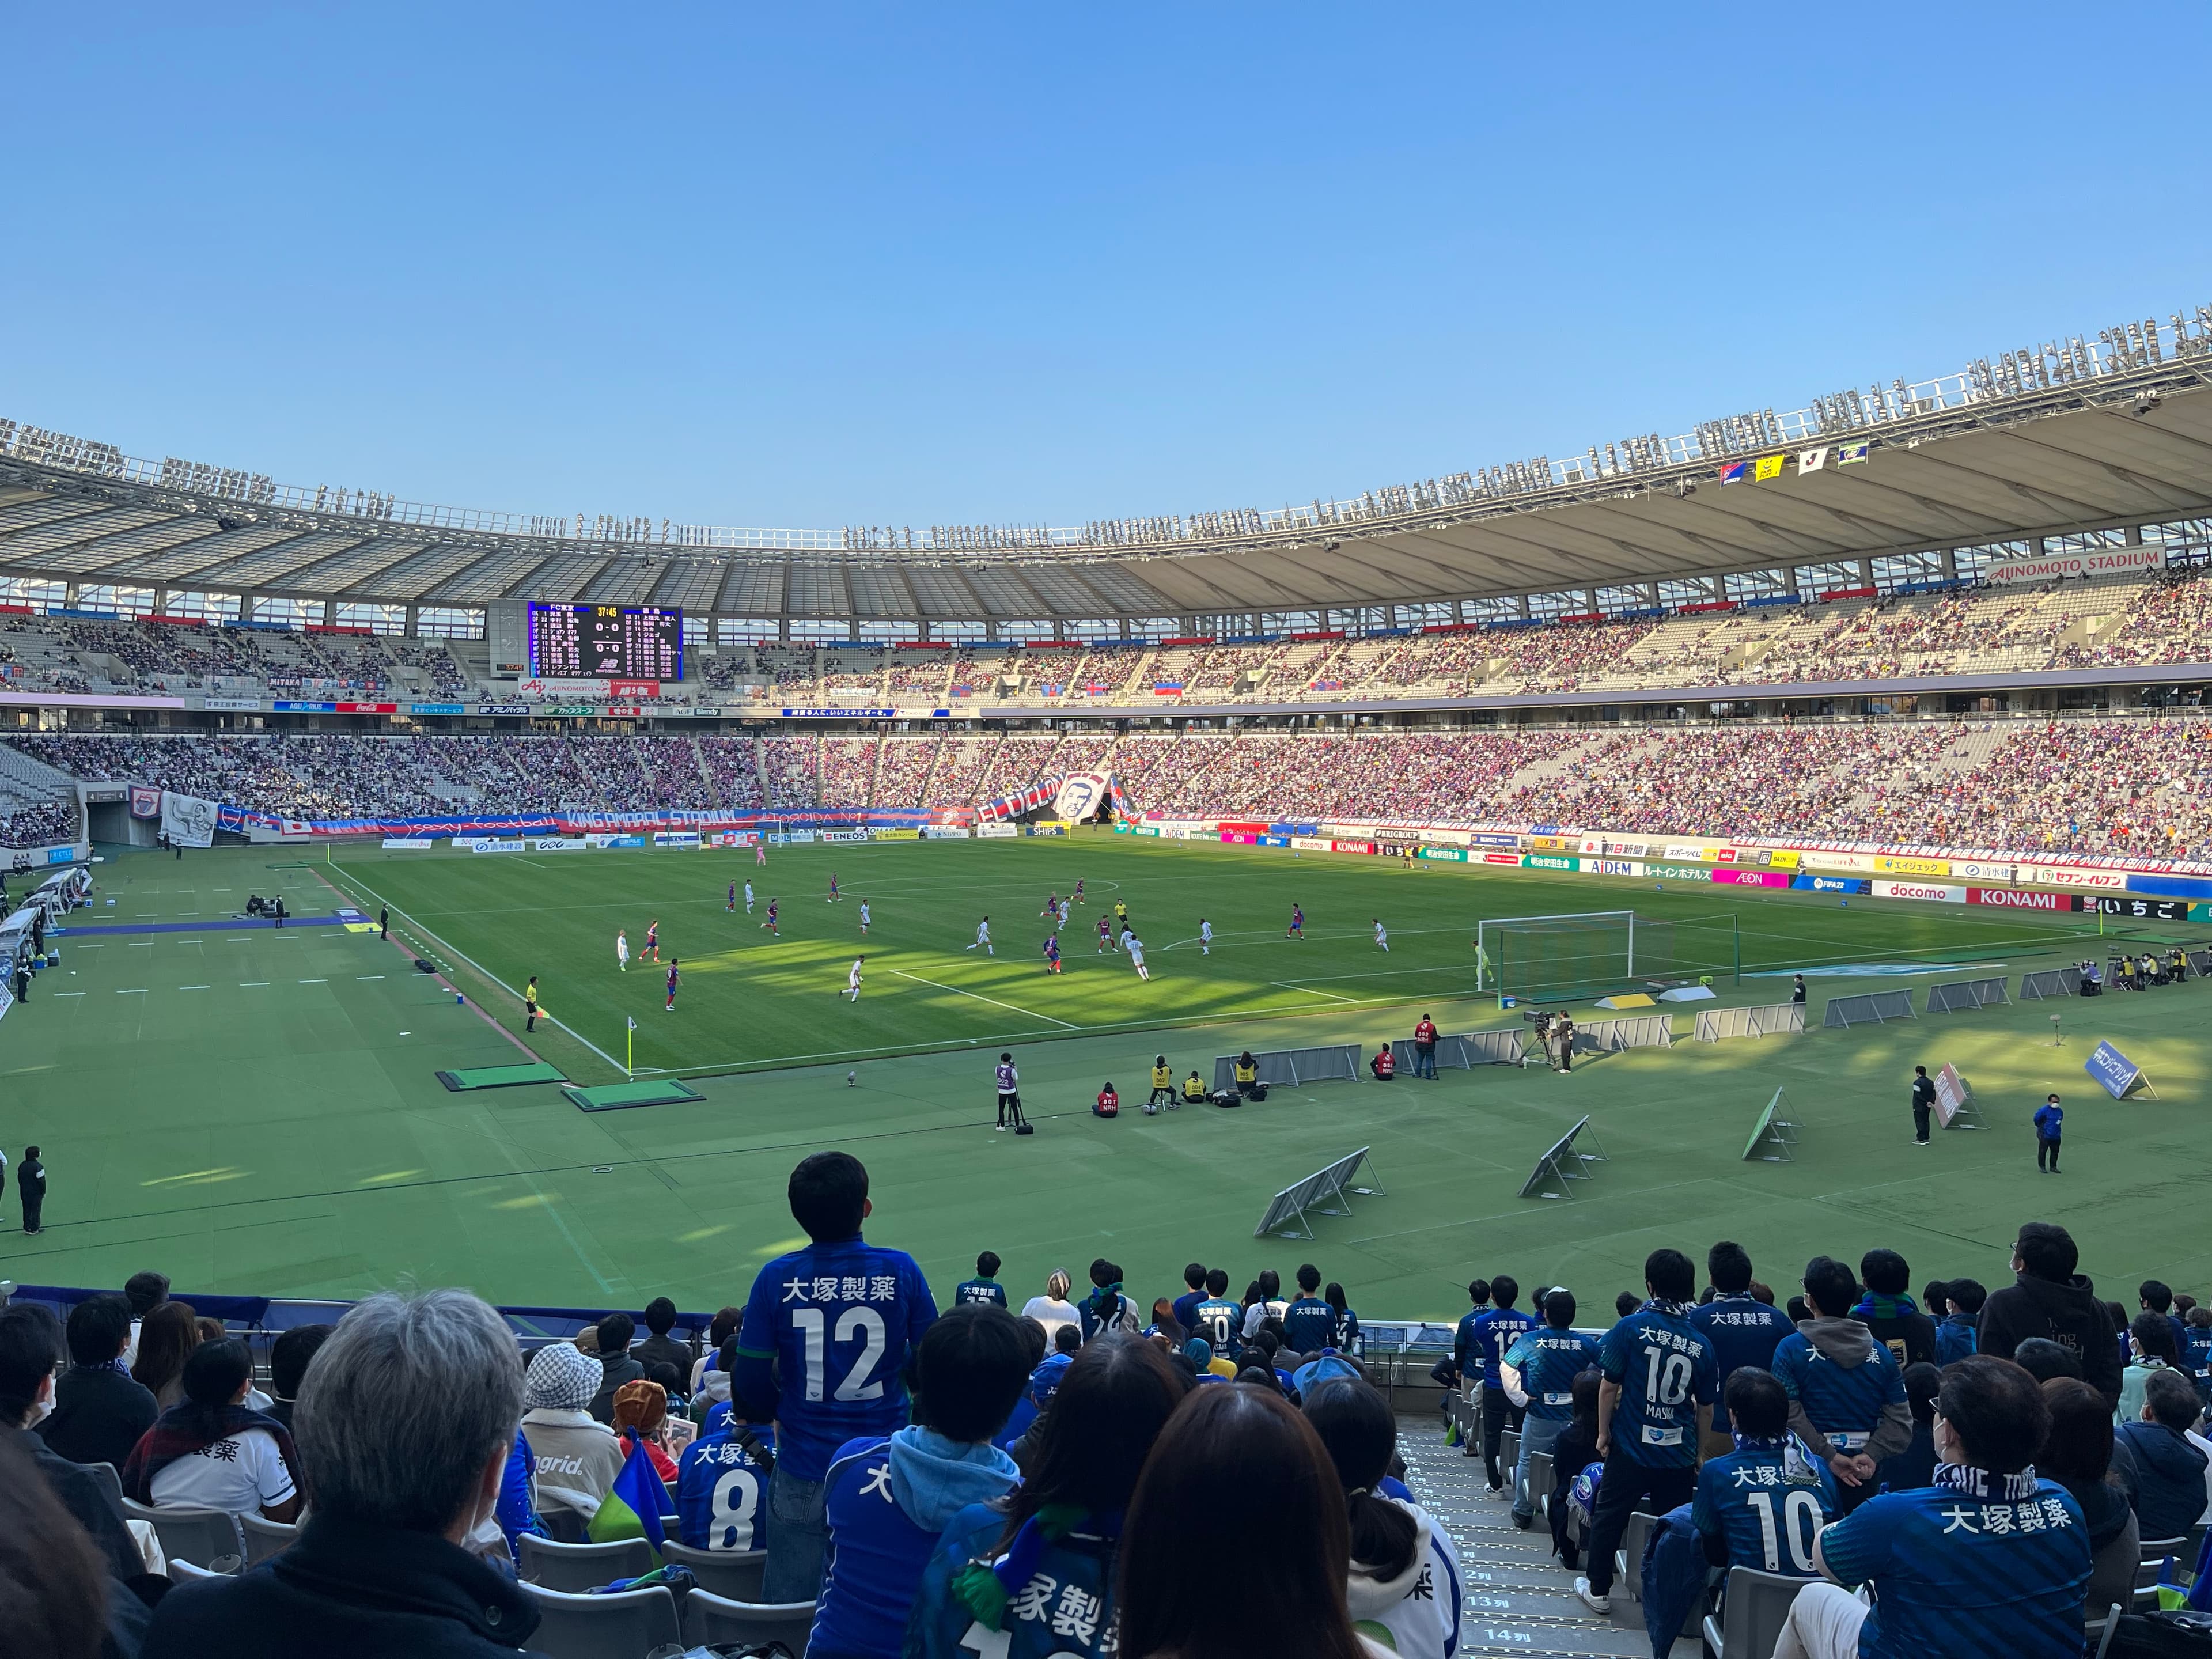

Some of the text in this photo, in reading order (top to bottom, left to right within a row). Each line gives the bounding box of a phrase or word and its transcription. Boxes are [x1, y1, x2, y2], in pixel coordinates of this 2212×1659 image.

[1990, 551, 2158, 580] AJINOMOTO STADIUM
[598, 607, 616, 617] 37:45
[269, 677, 300, 686] MITAKA
[289, 702, 323, 710] AQUARIUS
[2011, 701, 2020, 709] 35
[2112, 698, 2122, 707] 34
[491, 706, 528, 714] アミノバイタル
[791, 709, 887, 717] 頑張る人に、いいエネルギーを。
[567, 810, 736, 828] KING AMARAL STADIUM
[414, 816, 556, 836] sexy-football
[1033, 827, 1056, 835] SHIPS
[1190, 831, 1203, 840] ROUTE
[1300, 839, 1323, 849] docomo
[1336, 843, 1368, 853] KONAMI
[1605, 843, 1643, 855] 朝日新聞
[1426, 849, 1460, 861] 明治安田生命
[1668, 848, 1700, 858] スポーツくじ
[1530, 857, 1570, 869] 明治安田生命
[1834, 857, 1861, 867] LIFEVAL
[1894, 861, 1938, 872] エイジェック
[1644, 866, 1711, 881] ルートインホテルズ
[1982, 866, 2018, 878] 清水建
[1890, 883, 1946, 900] docomo
[1980, 889, 2055, 909] KONAMI
[2105, 899, 2175, 919] いちご
[782, 1275, 896, 1303] 大塚製薬
[964, 1286, 997, 1297] 大塚製薬
[1199, 1306, 1232, 1316] 大塚製薬
[1255, 1308, 1282, 1316] 大塚製薬
[1296, 1307, 1327, 1316] 大塚製薬
[1488, 1320, 1528, 1330] 大塚製薬
[1710, 1312, 1772, 1326] 大塚製薬
[1536, 1337, 1582, 1351] 大塚製薬
[1638, 1325, 1703, 1359] 大塚製薬
[792, 1306, 885, 1402] 12
[1805, 1343, 1880, 1365] 大薬
[1643, 1346, 1692, 1406] 10
[694, 1442, 777, 1466] 大塚
[1732, 1465, 1823, 1488] 大塚
[709, 1469, 759, 1552] 8
[1941, 1498, 2073, 1535] 大塚製薬
[1747, 1490, 1823, 1572] 10
[1467, 1596, 1509, 1608] 13列
[1484, 1628, 1532, 1643] 14列
